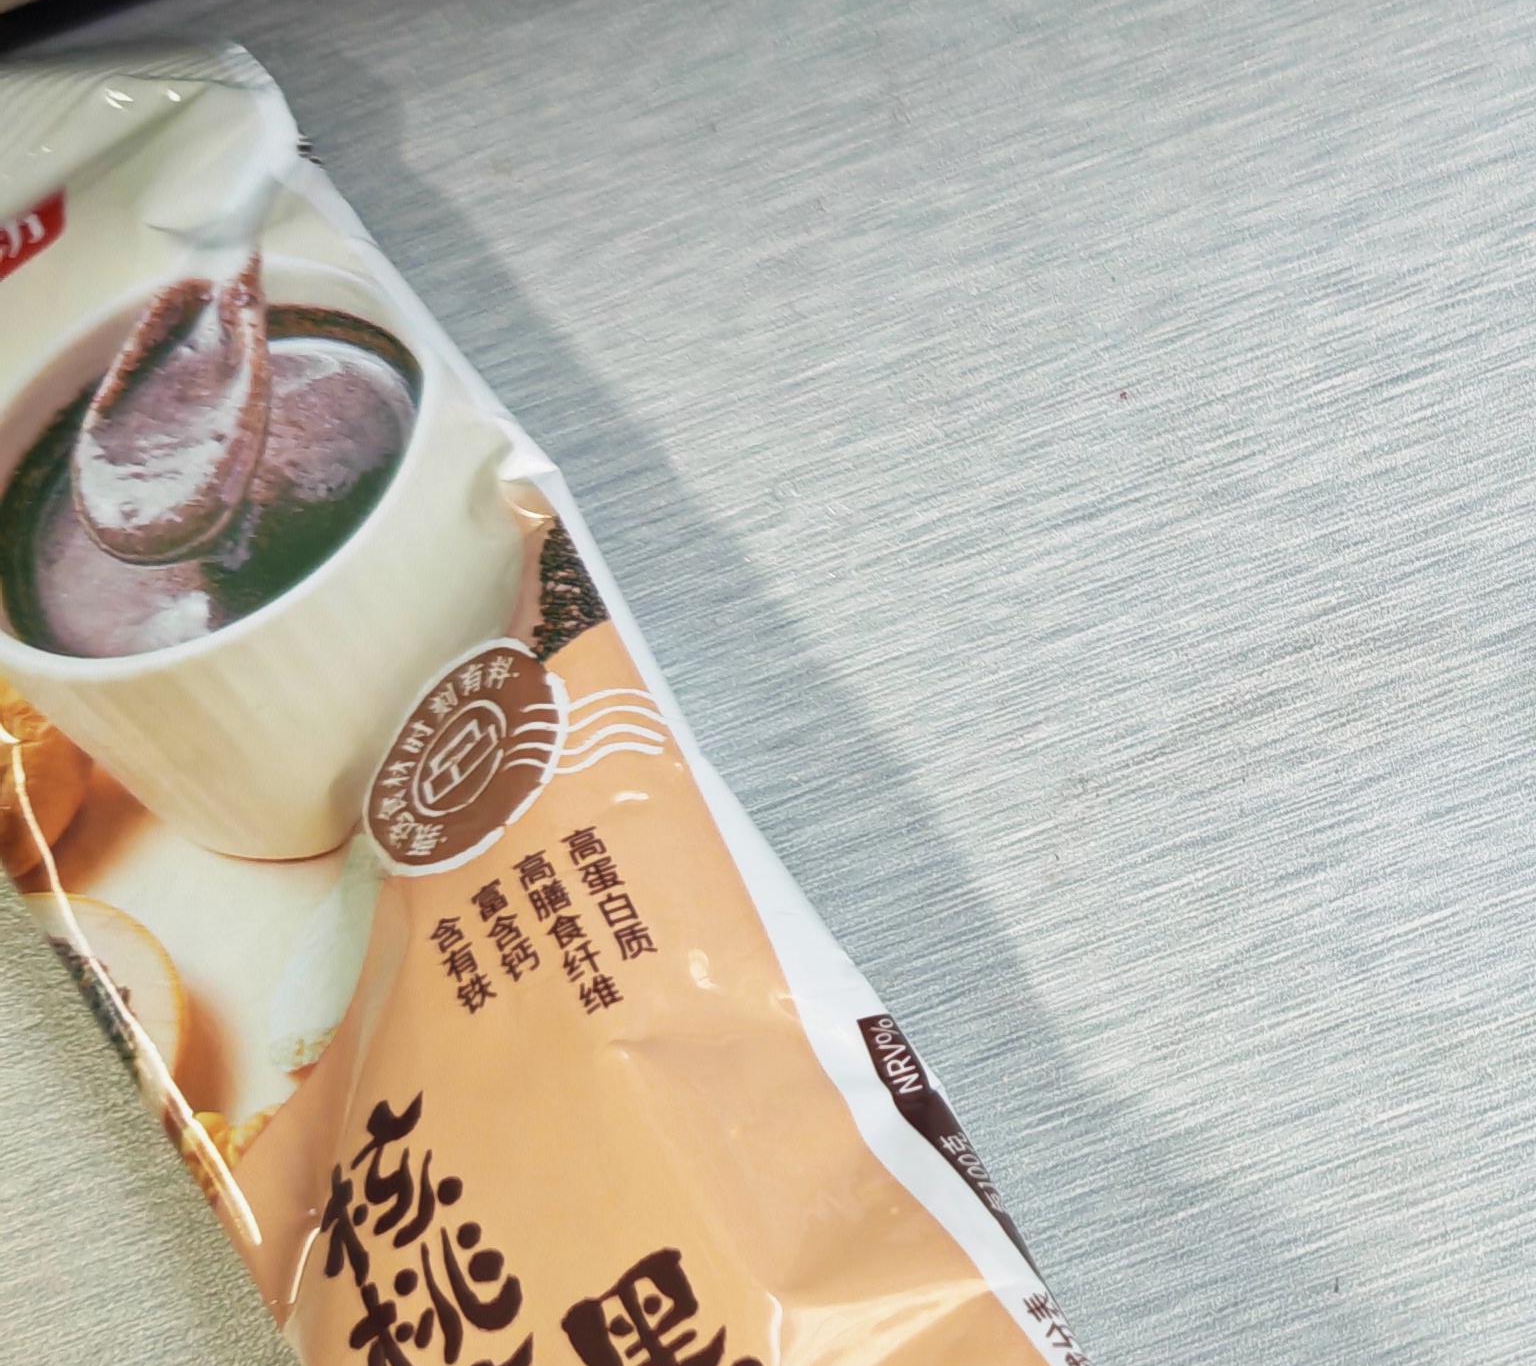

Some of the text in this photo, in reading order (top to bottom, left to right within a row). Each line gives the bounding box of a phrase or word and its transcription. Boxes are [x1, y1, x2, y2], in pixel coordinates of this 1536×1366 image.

[471, 879, 540, 981] 富含钙
[512, 850, 624, 1015] 高膳食纤维
[560, 826, 657, 960] 高蛋白质
[430, 915, 497, 1014] 含有铁
[869, 1017, 923, 1094] NRV%
